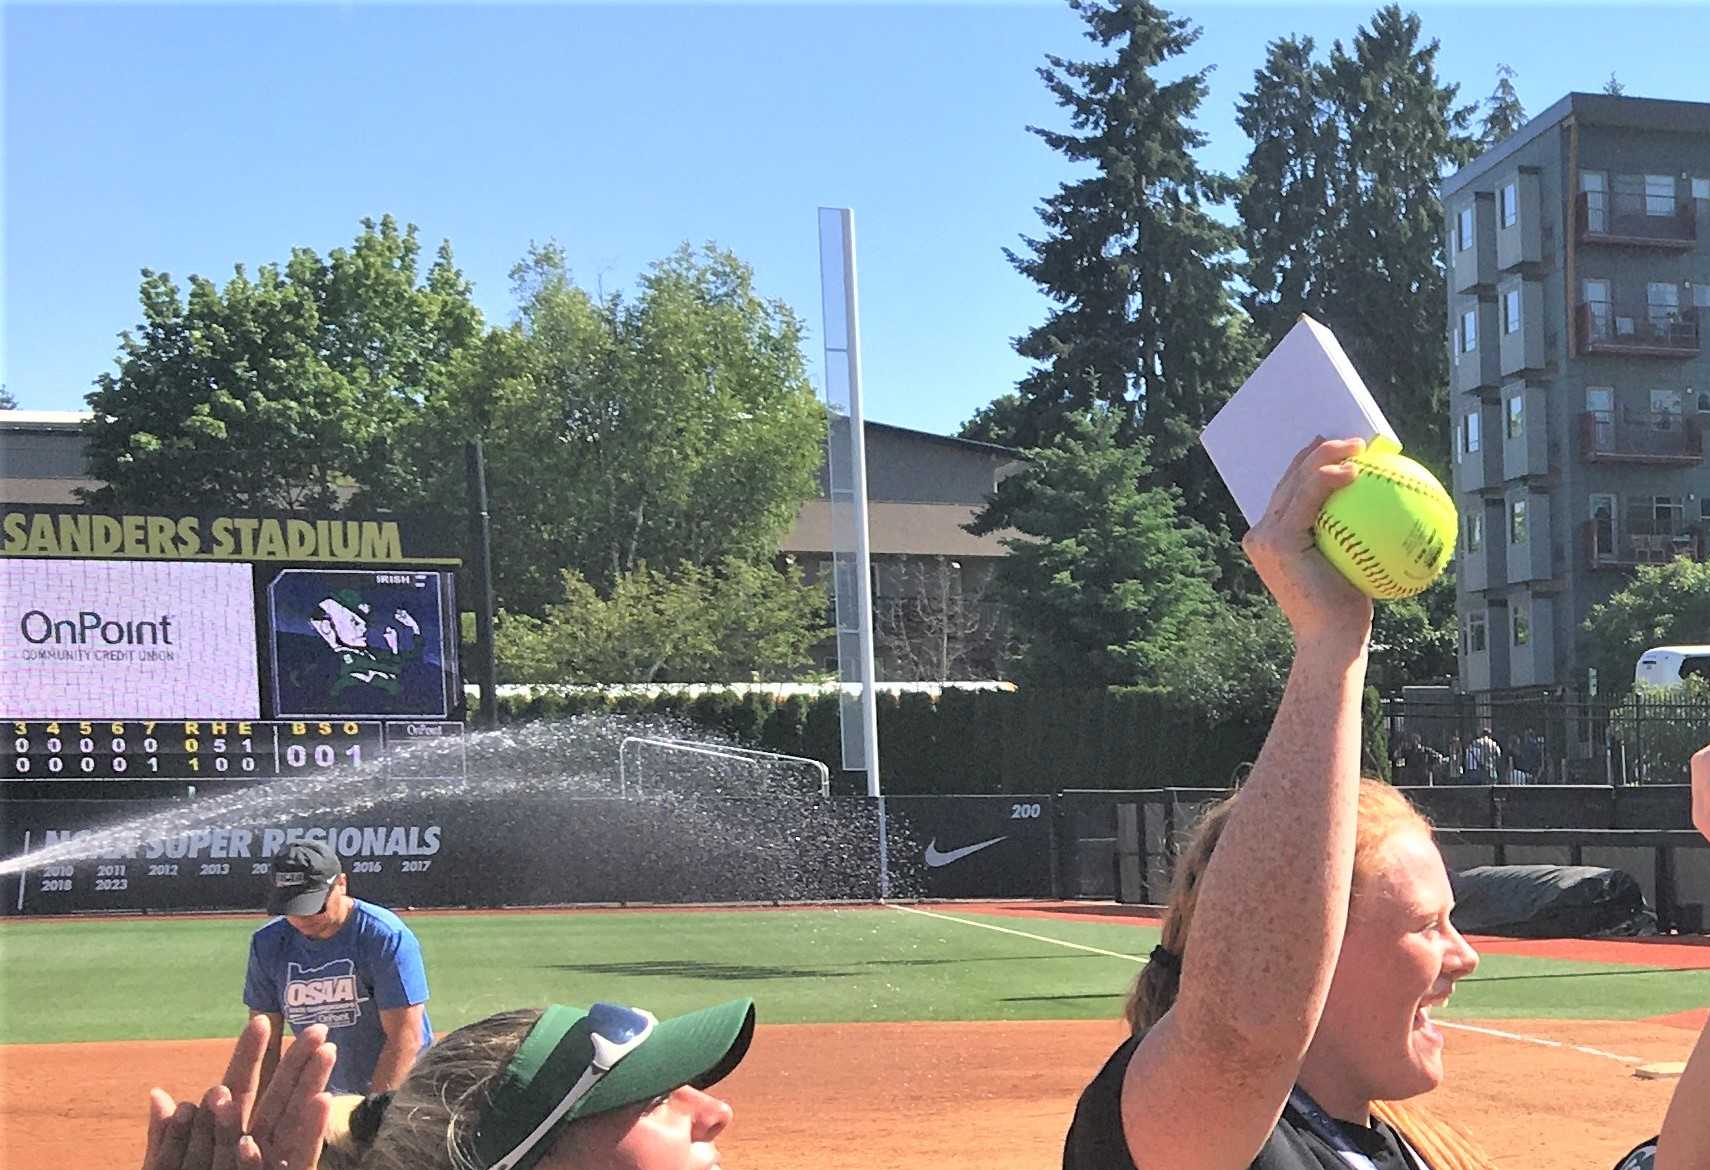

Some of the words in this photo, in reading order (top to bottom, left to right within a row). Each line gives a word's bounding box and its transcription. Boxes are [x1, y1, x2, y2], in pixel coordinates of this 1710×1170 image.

[3, 512, 201, 556] SANDERS
[211, 516, 402, 560] STADIUM
[376, 574, 410, 585] IRISH
[21, 610, 173, 645] OnPoint
[23, 649, 91, 662] COMMUNITY
[94, 650, 135, 662] CREDIT
[138, 650, 175, 662] UNION
[15, 721, 27, 735] 3
[47, 721, 60, 735] 4
[80, 721, 92, 735] 5
[112, 721, 125, 735] 6
[143, 721, 157, 735] 7
[185, 721, 199, 735] R
[212, 721, 227, 735] H
[239, 721, 252, 735] E
[292, 721, 306, 735] B
[318, 721, 332, 735] S
[343, 721, 359, 735] O
[15, 738, 30, 753] 0
[47, 738, 62, 753] 0
[80, 738, 94, 753] 0
[111, 738, 126, 753] 0
[144, 738, 158, 753] 0
[185, 738, 198, 752] 0
[213, 738, 227, 753] 5
[241, 738, 252, 752] 1
[287, 745, 306, 767] 0
[315, 745, 335, 767] 0
[345, 745, 361, 767] 1
[16, 757, 30, 772] 0
[48, 757, 63, 772] 0
[81, 757, 95, 772] 0
[113, 757, 127, 772] 0
[147, 757, 158, 772] 1
[188, 757, 199, 771] 1
[215, 757, 229, 772] 0
[242, 757, 255, 771] 0
[1010, 803, 1041, 819] 200
[145, 829, 252, 859] SUPER
[97, 864, 127, 877] 2011
[148, 864, 179, 876] 2012
[200, 863, 231, 876] 2013
[352, 861, 383, 873] 2016
[401, 860, 433, 873] 2017
[95, 879, 129, 891] 2023
[287, 978, 355, 1008] OSAA
